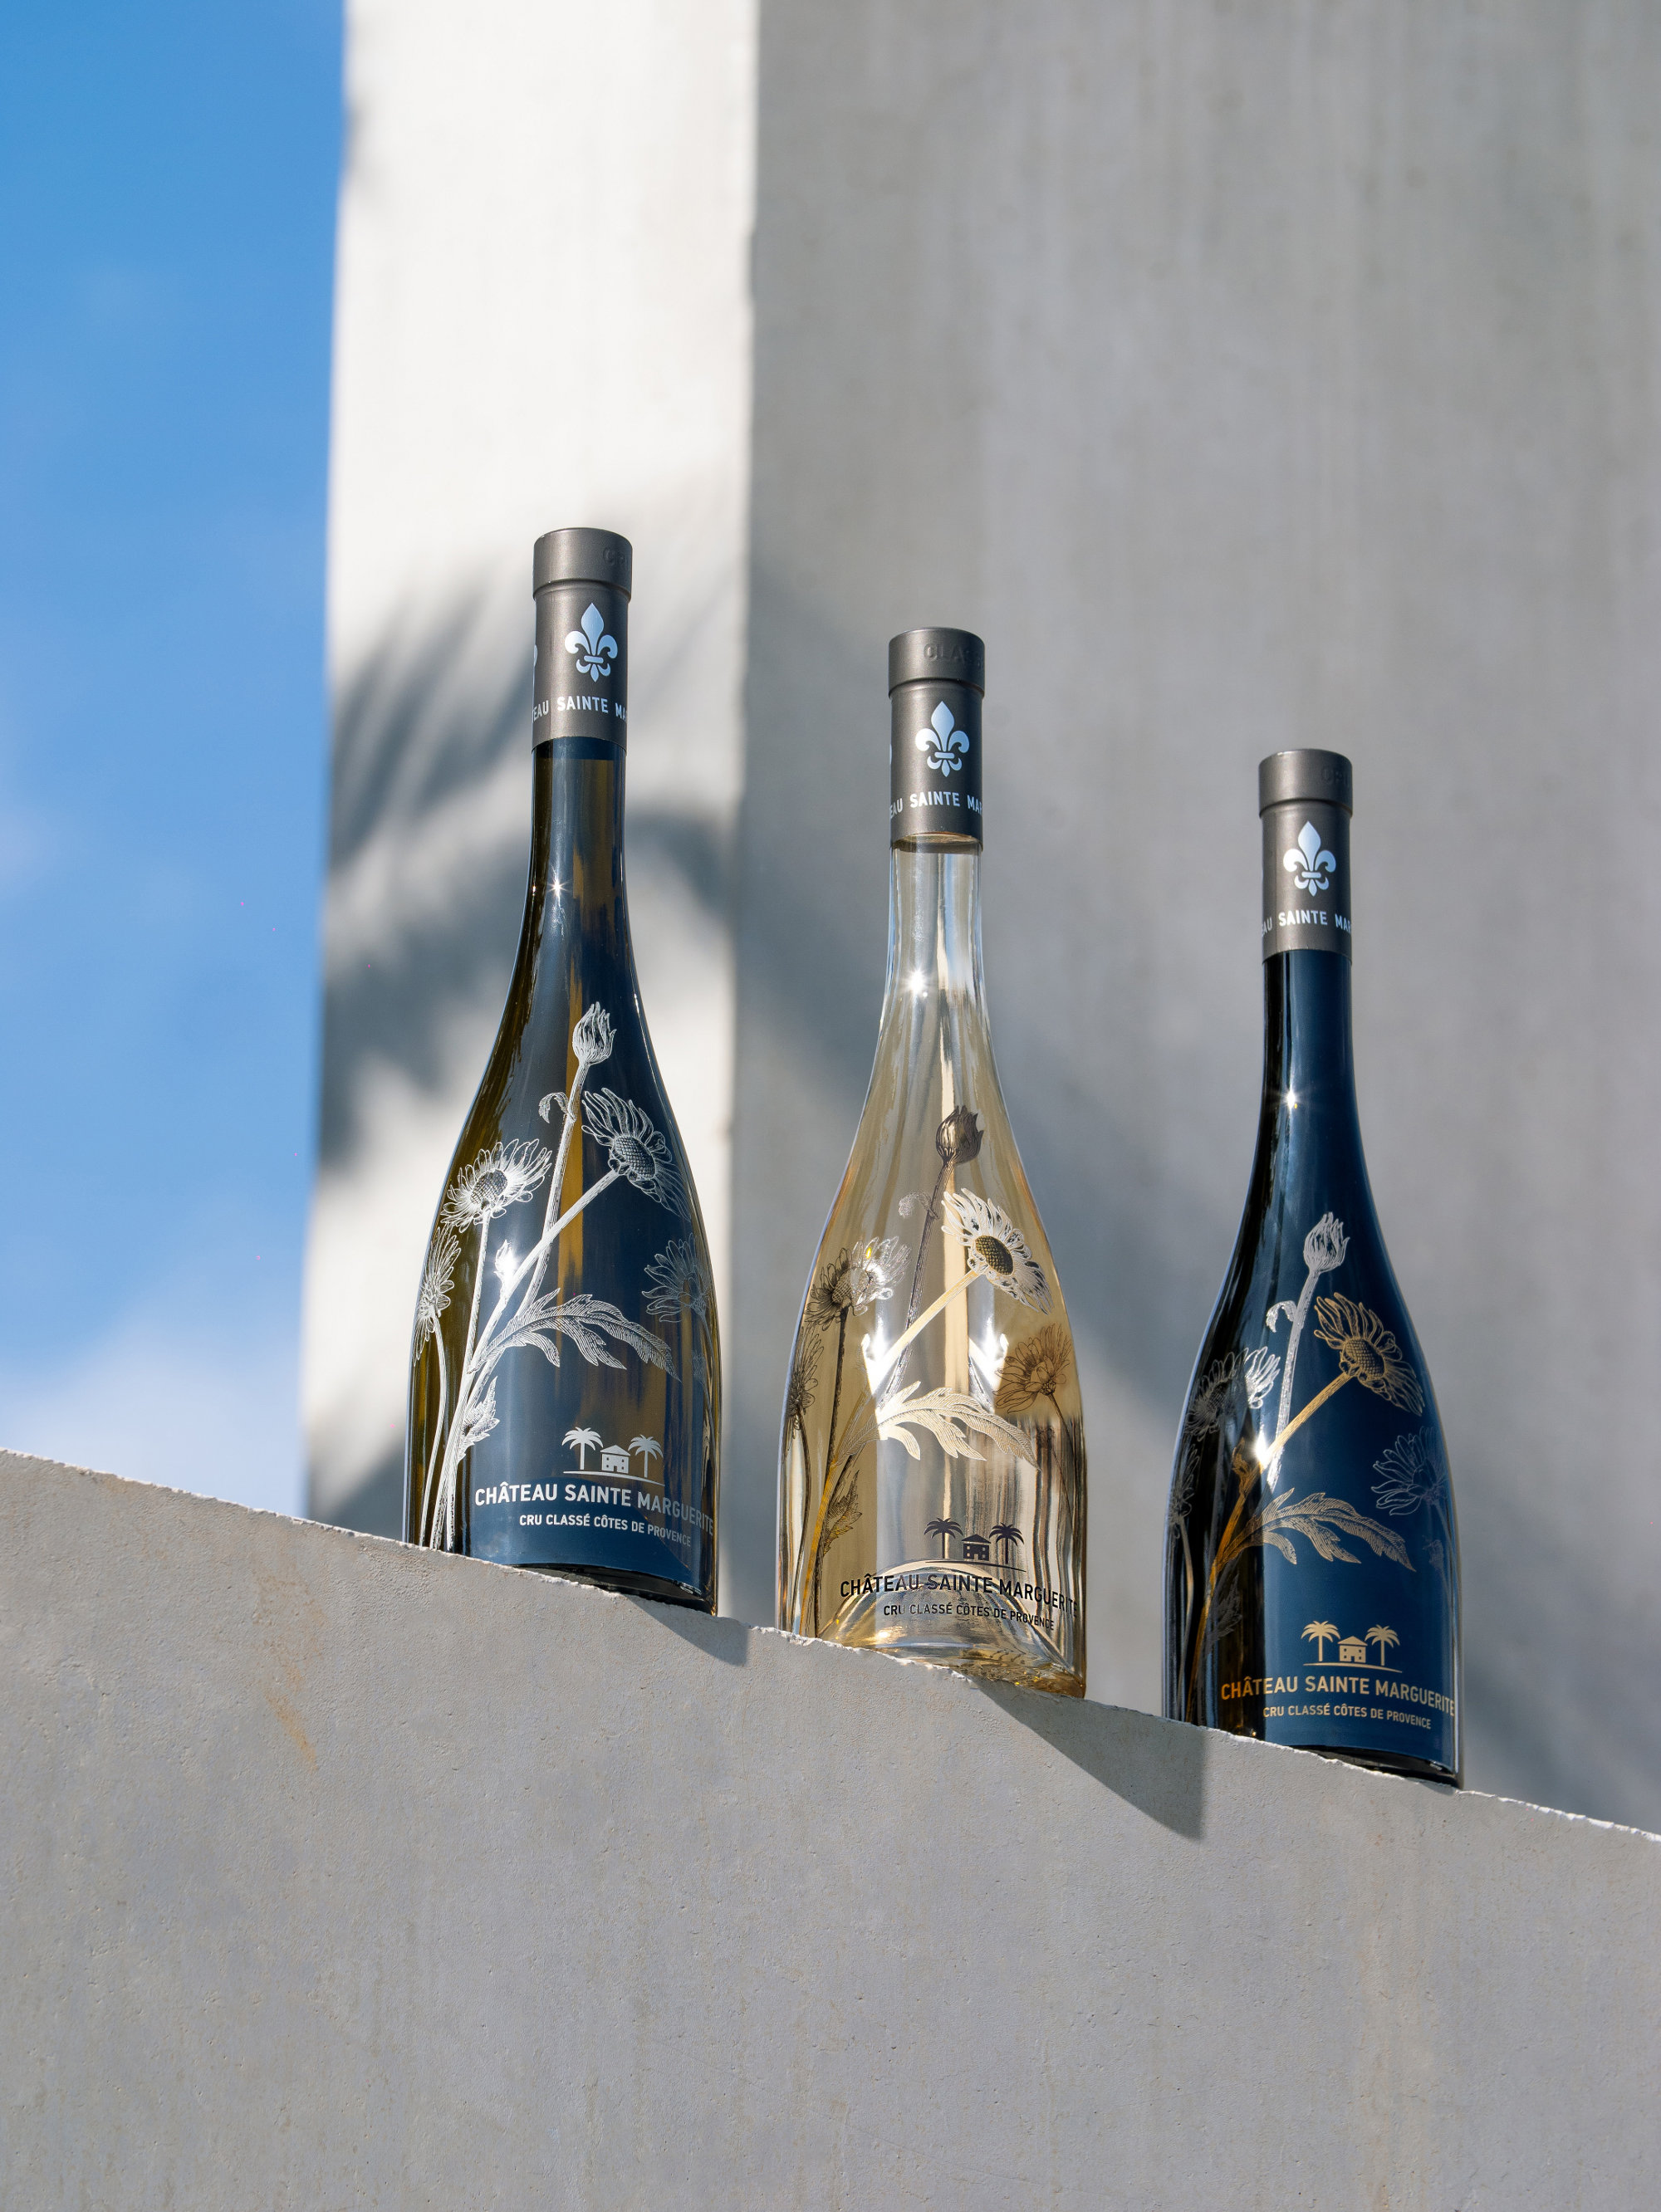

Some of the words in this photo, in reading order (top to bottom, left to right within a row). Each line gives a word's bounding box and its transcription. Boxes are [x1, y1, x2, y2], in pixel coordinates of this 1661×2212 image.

[556, 695, 609, 713] SAINTE
[909, 790, 961, 808] SAINTE
[1278, 909, 1328, 927] SAINTE
[474, 1480, 558, 1507] CHÂTEAU
[564, 1483, 632, 1507] SAINTE
[636, 1490, 714, 1537] MARGUERITE
[519, 1514, 542, 1526] CRU
[546, 1513, 590, 1527] CLASSÉ
[594, 1514, 629, 1531] CÔTES
[631, 1520, 645, 1534] DE
[647, 1524, 691, 1548] PROVENCE
[840, 1573, 920, 1598] CHÂTEAU
[926, 1573, 993, 1594] SAINTE
[999, 1578, 1078, 1619] MARGUERITE
[883, 1604, 906, 1616] CRU
[909, 1602, 953, 1616] CLASSÉ
[956, 1603, 991, 1618] CÔTES
[993, 1608, 1007, 1620] DE
[1010, 1610, 1055, 1631] PROVENCE
[1220, 1676, 1299, 1701] CHÂTEAU
[1305, 1675, 1370, 1696] SAINTE
[1375, 1679, 1456, 1717] MARGUERITE
[1262, 1705, 1285, 1718] CRU
[1287, 1702, 1330, 1717] CLASSÉ
[1333, 1703, 1369, 1719] CÔTES
[1370, 1707, 1384, 1720] DE
[1386, 1710, 1432, 1730] PROVENCE
